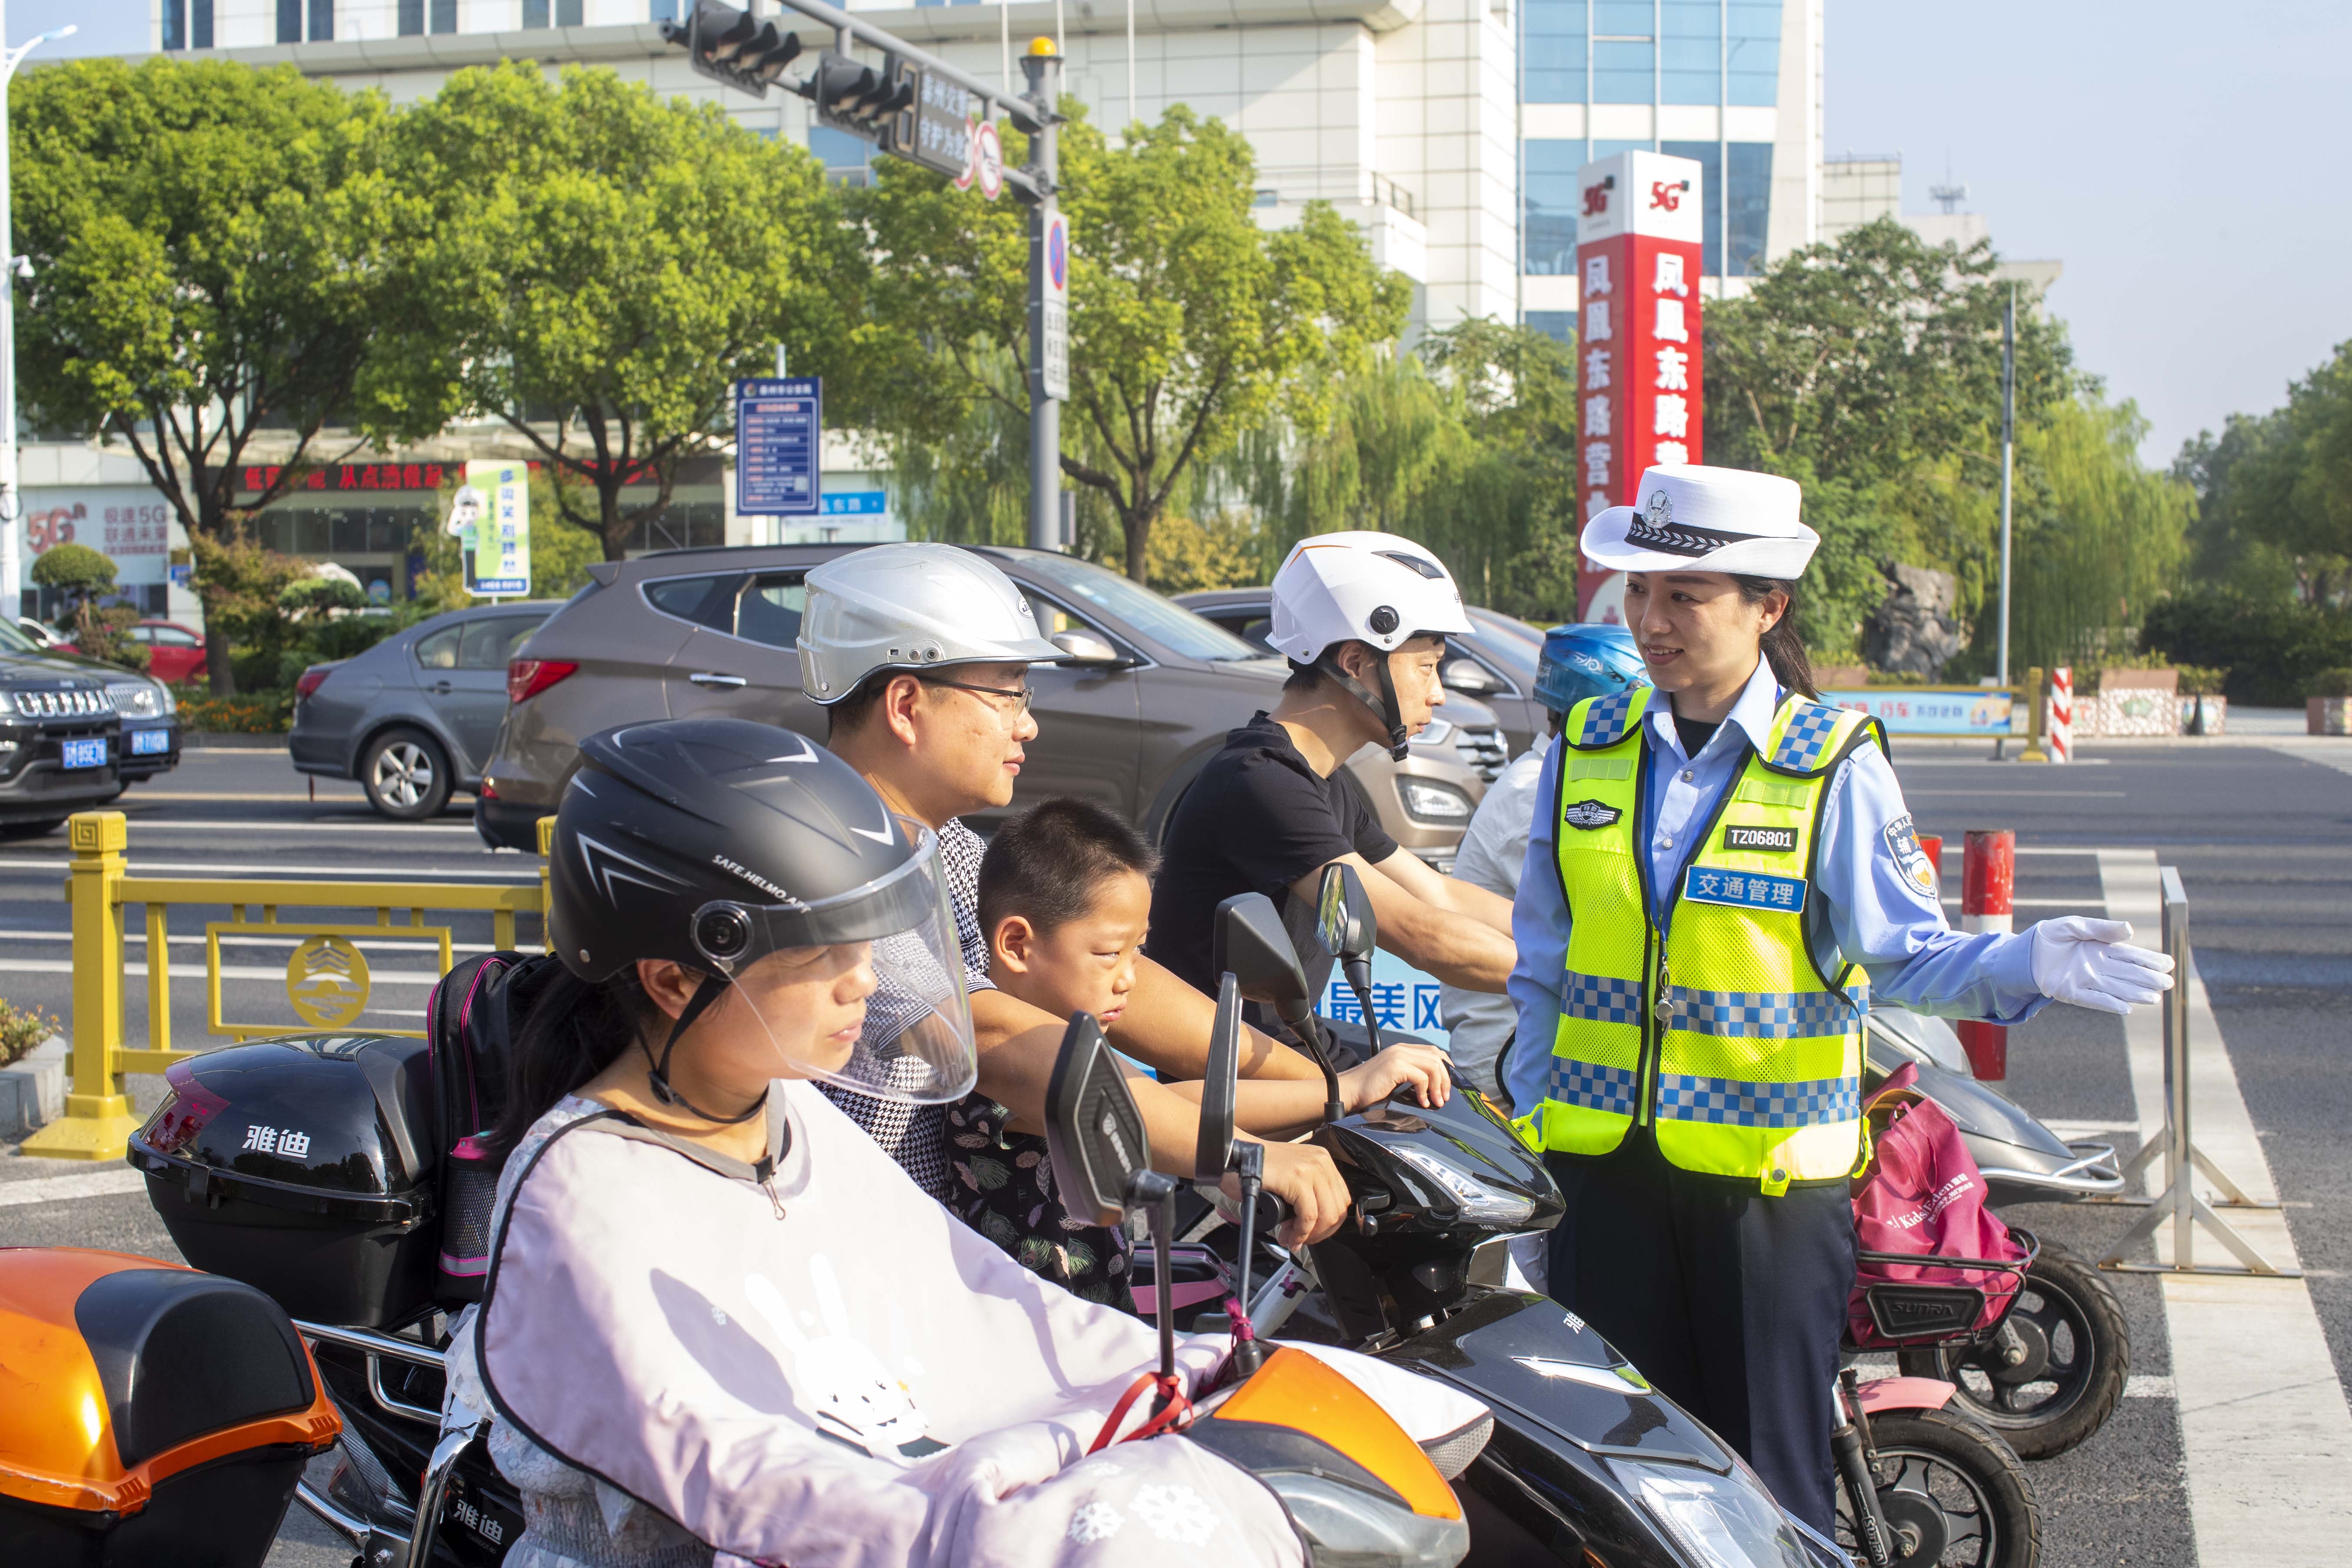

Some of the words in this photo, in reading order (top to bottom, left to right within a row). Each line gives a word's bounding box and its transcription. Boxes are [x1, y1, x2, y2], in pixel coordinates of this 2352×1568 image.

[1649, 180, 1687, 211] 5G
[245, 465, 326, 490] 低碳能
[339, 463, 443, 489] 从点滴做起
[28, 506, 76, 554] 5G
[1731, 829, 1792, 848] TZ06801
[1698, 873, 1793, 906] 交通管理
[1314, 982, 1446, 1031] 最美风
[242, 1125, 310, 1159] 雅迪
[1899, 1210, 1927, 1228] Kids
[1922, 1182, 1954, 1215] Eden
[1892, 1302, 1953, 1315] SUNRA
[453, 1499, 503, 1545] 雅迪
[1863, 1519, 1885, 1563] SUNRA
